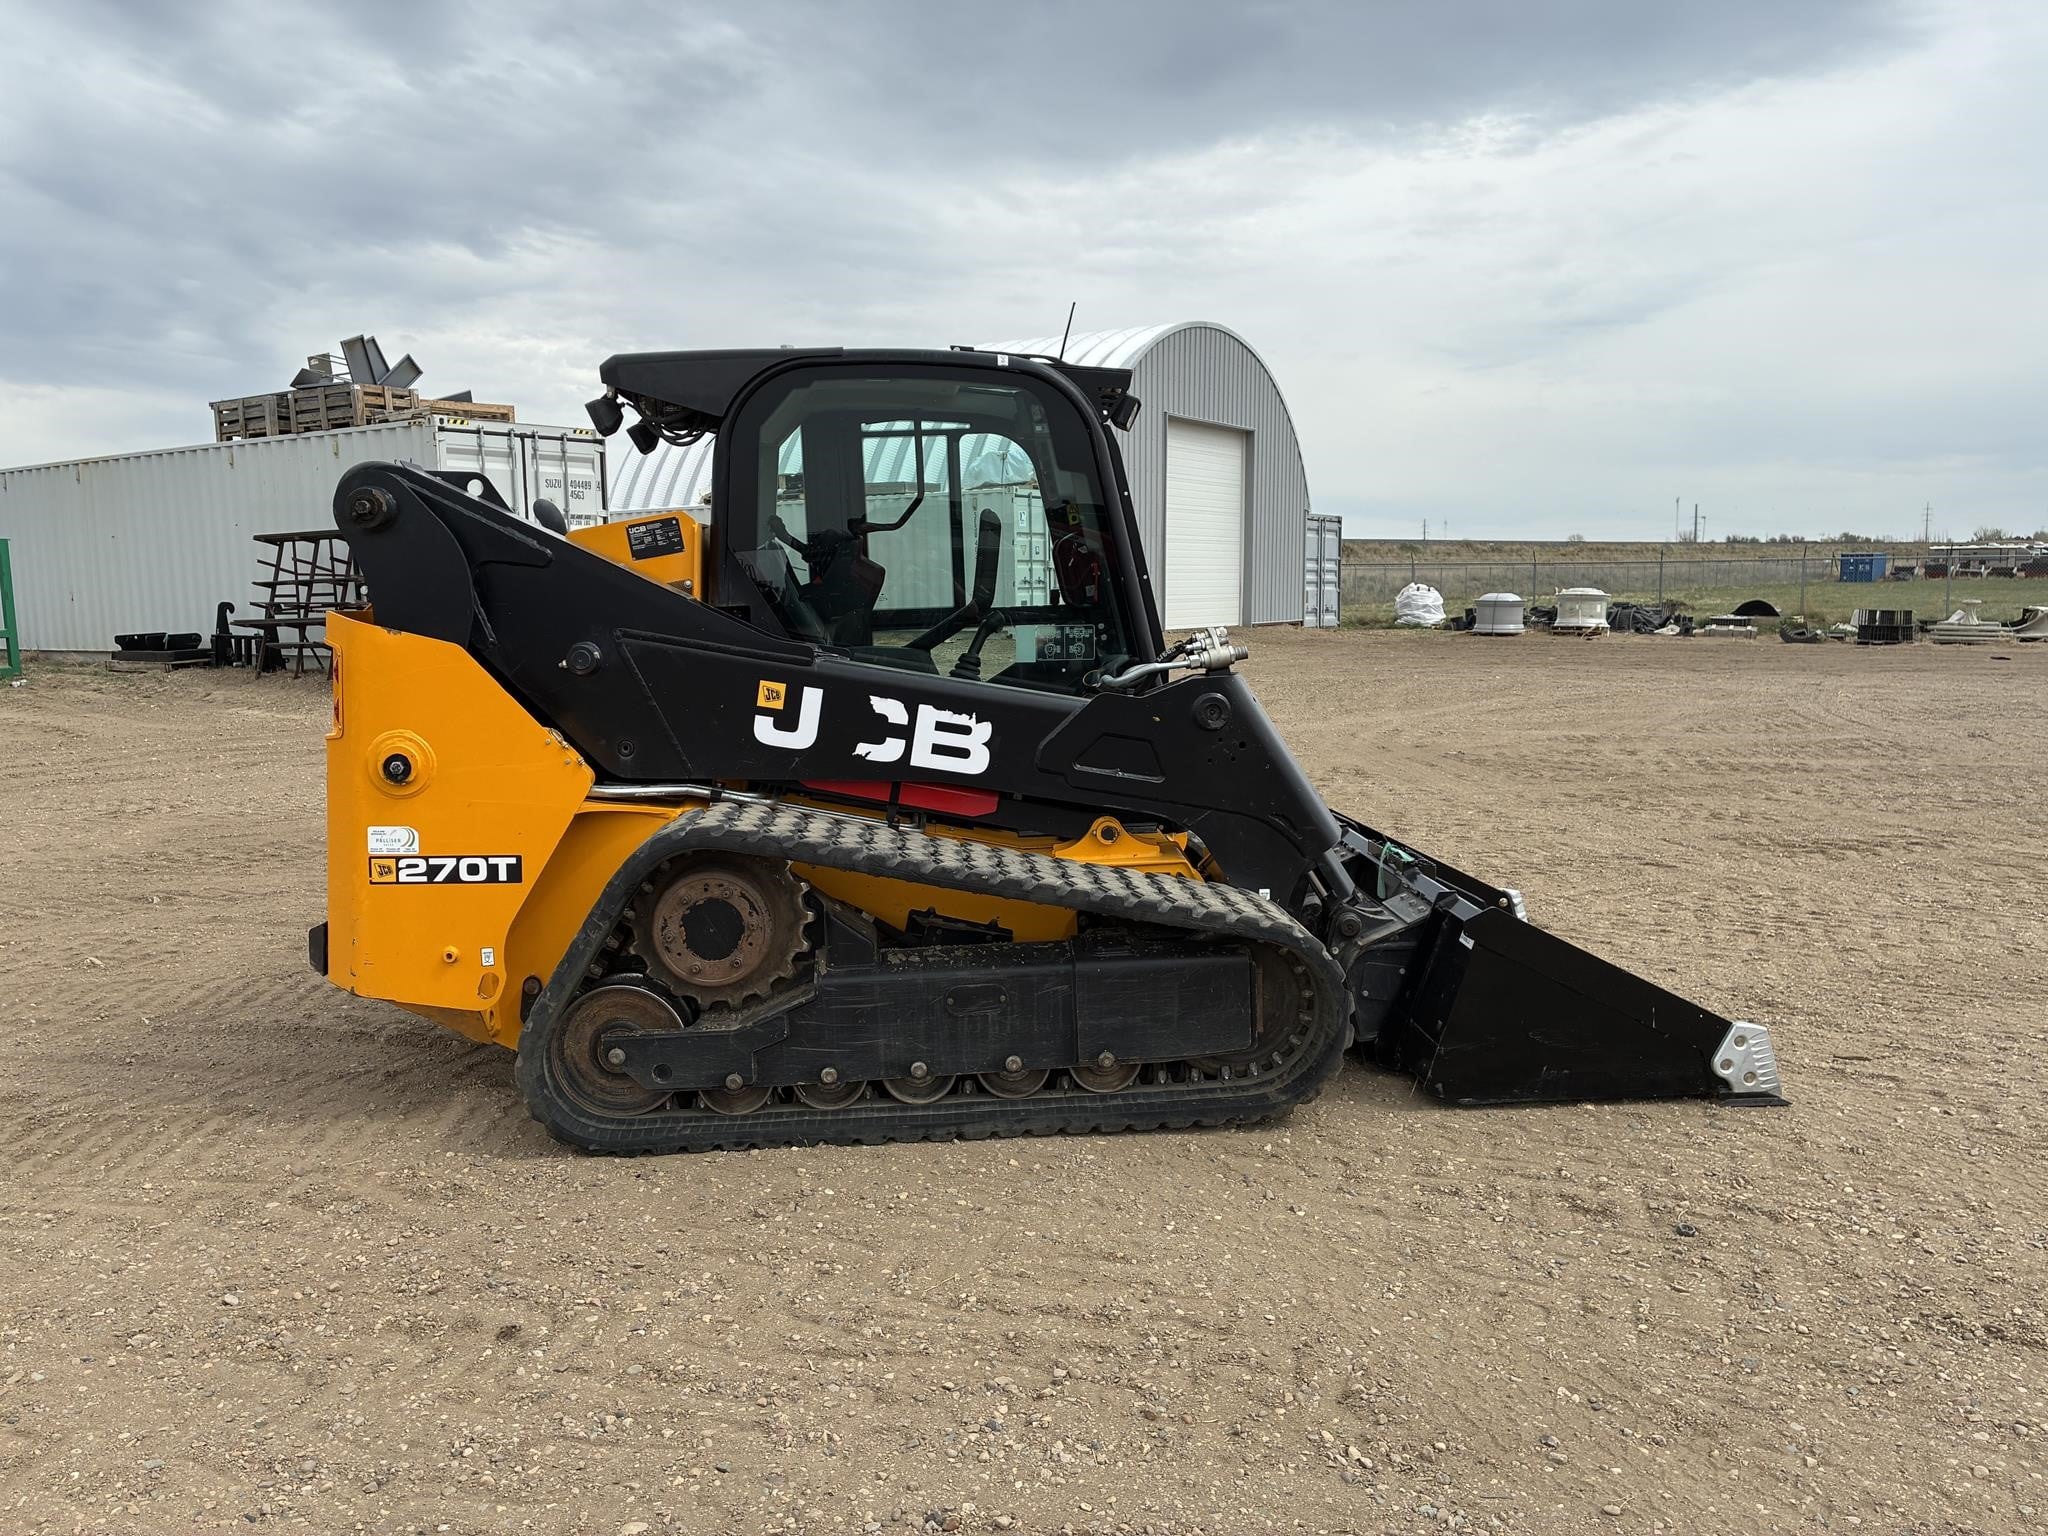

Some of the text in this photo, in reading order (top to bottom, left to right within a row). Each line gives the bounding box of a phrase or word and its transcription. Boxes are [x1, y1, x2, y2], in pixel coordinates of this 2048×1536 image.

[545, 479, 562, 489] SUZU
[569, 491, 585, 500] 4563
[628, 525, 647, 534] JCB
[398, 857, 517, 883] 270T
